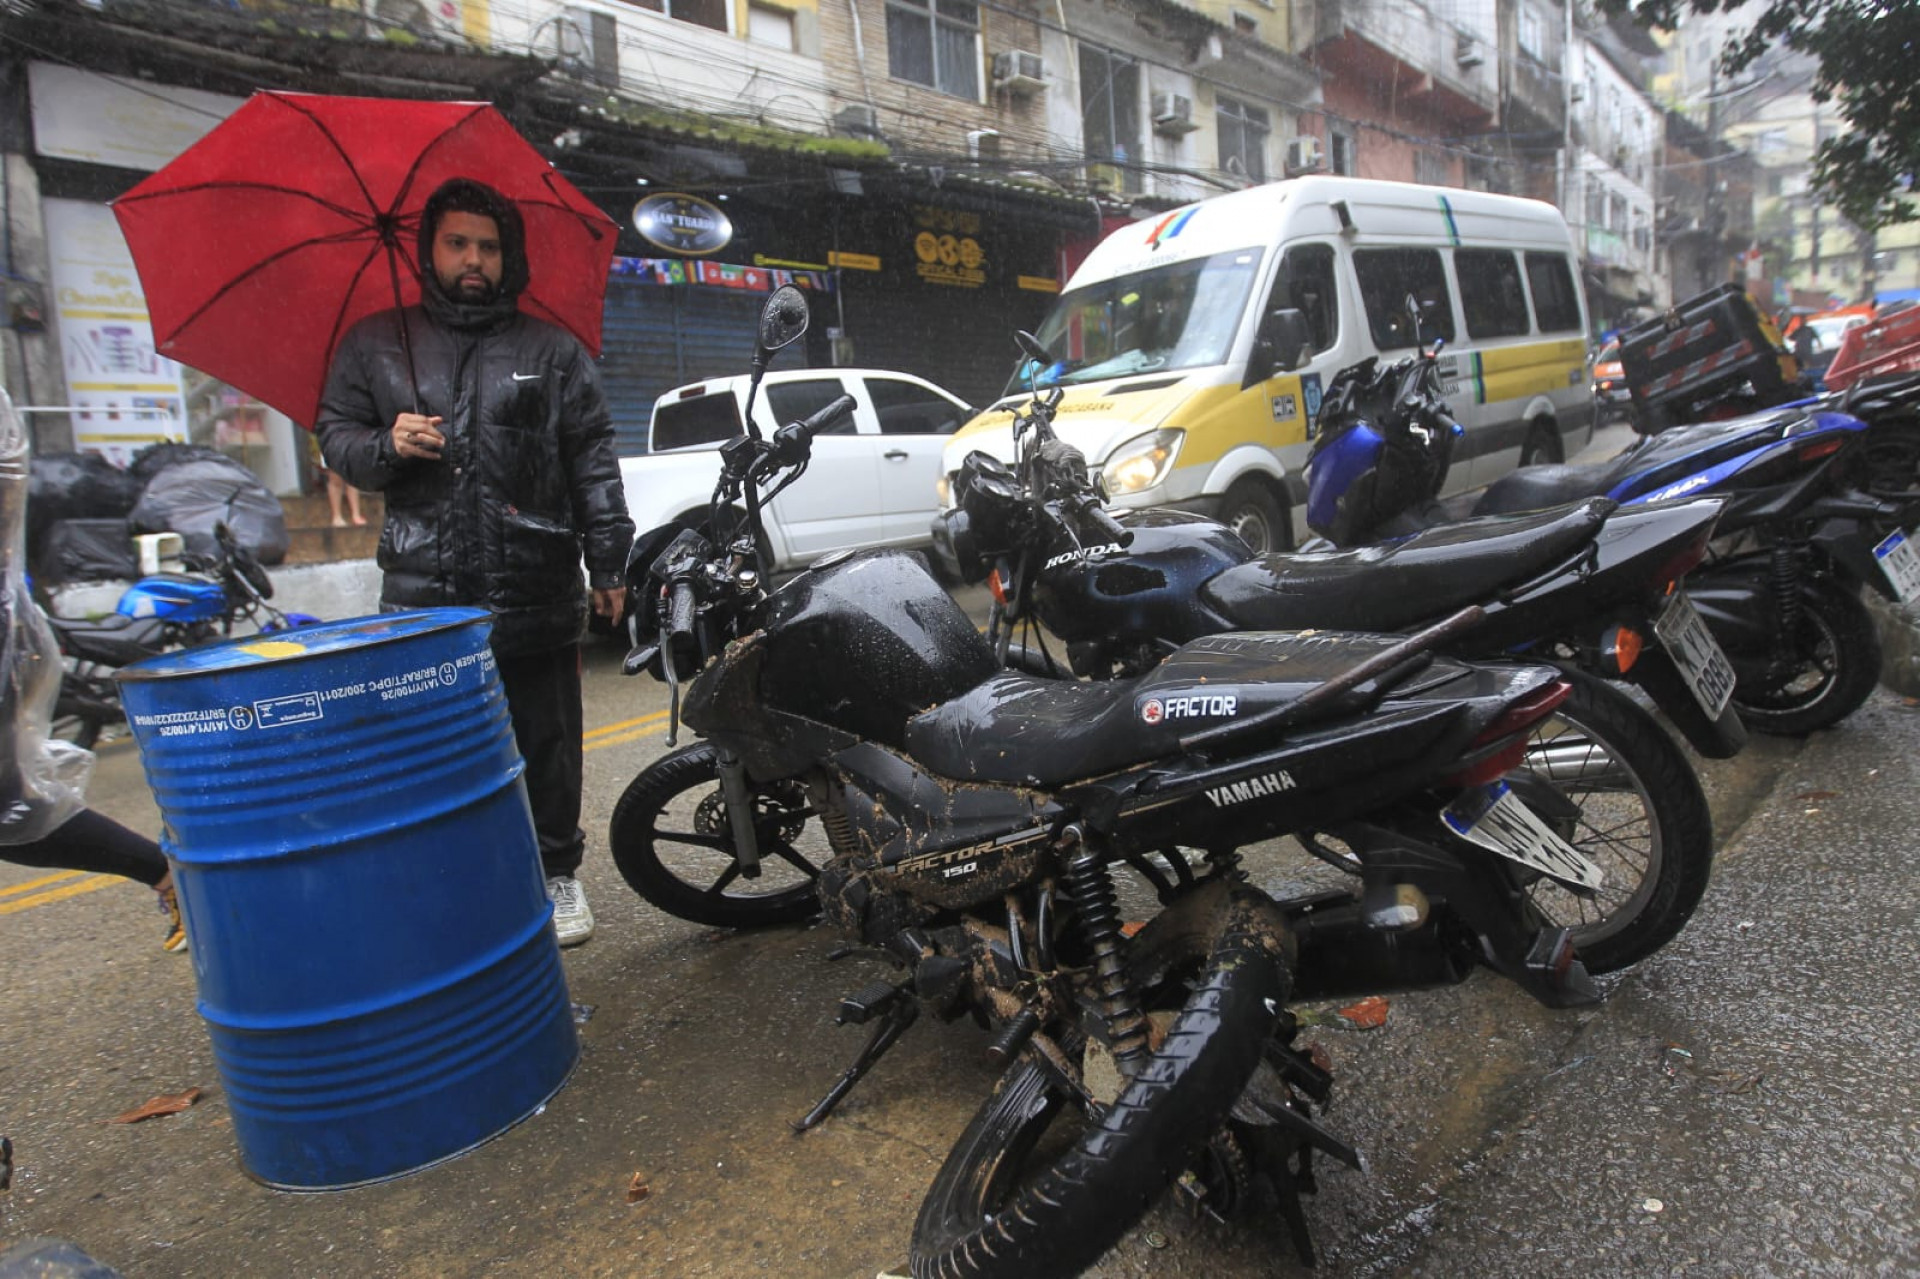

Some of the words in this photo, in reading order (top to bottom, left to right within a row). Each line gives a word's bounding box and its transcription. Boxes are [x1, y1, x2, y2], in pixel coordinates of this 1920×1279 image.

[1044, 543, 1126, 570] HONDA
[1164, 695, 1237, 720] FACTOR
[1205, 769, 1297, 807] YAMAHA
[895, 841, 995, 877] FACTOR
[942, 861, 979, 878] 150
